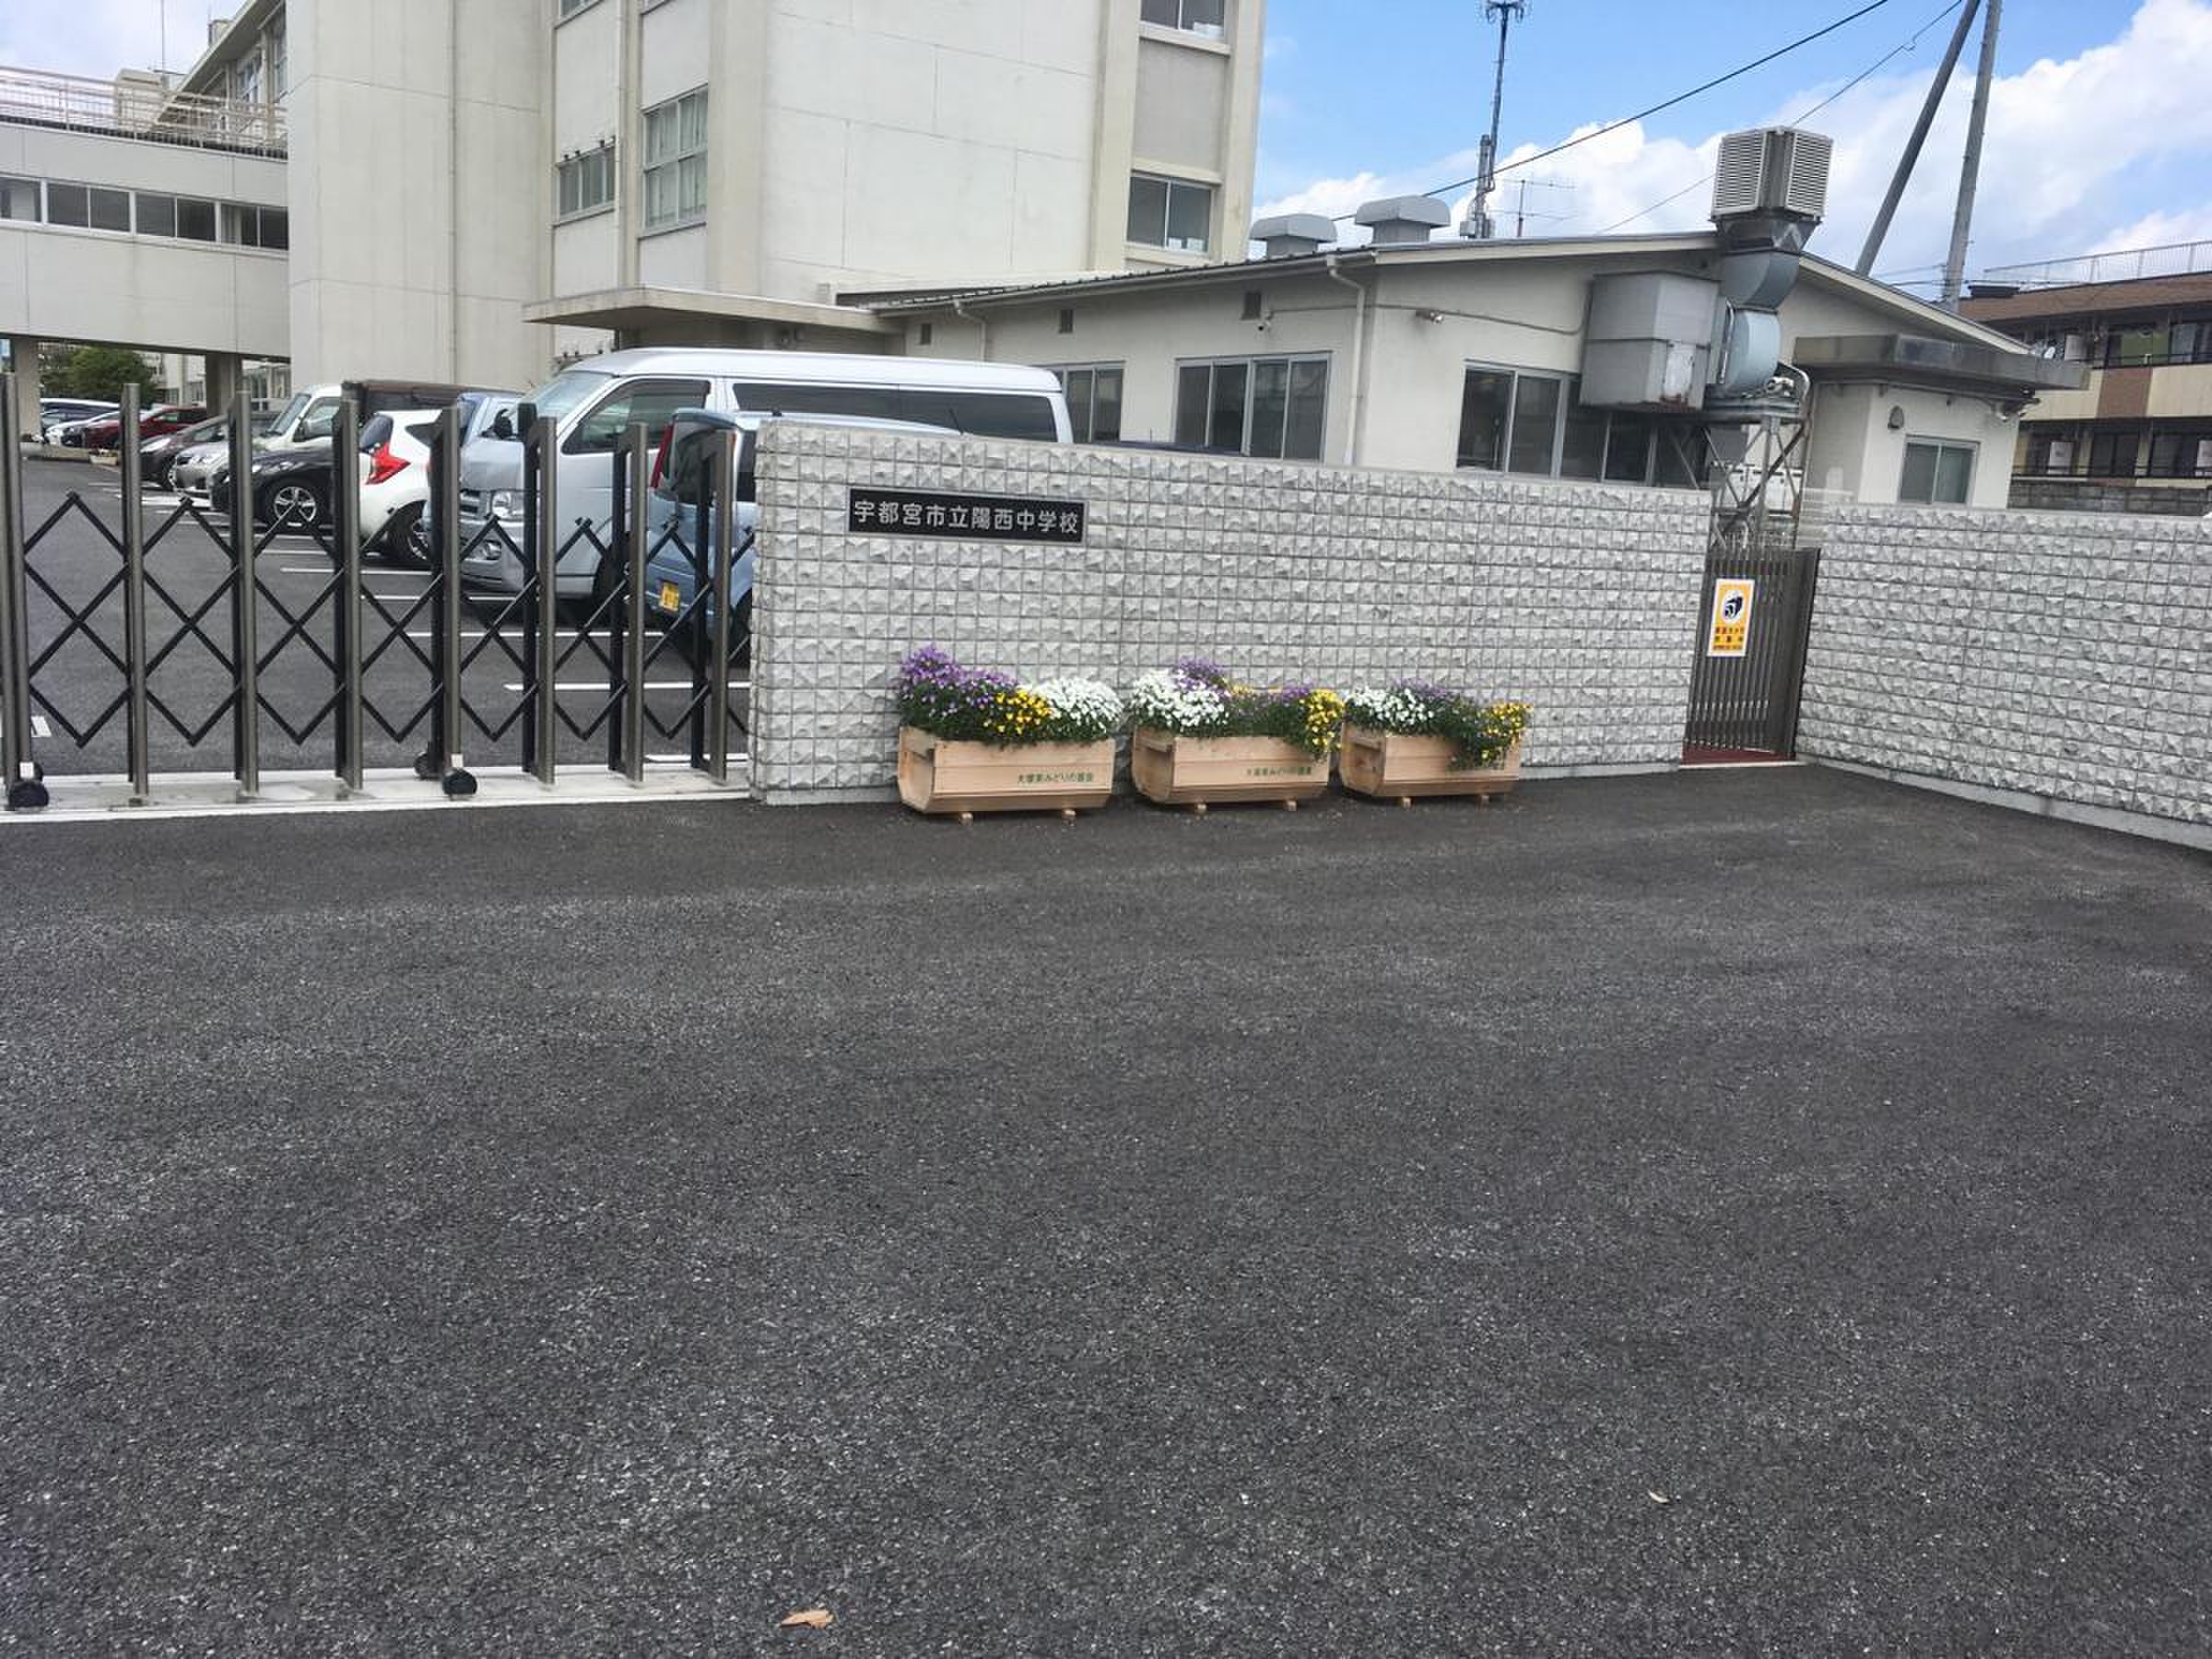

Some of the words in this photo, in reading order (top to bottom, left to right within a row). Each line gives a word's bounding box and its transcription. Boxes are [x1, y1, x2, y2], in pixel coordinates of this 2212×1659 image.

[854, 500, 1077, 534] 宇都宮市立陽西中学校
